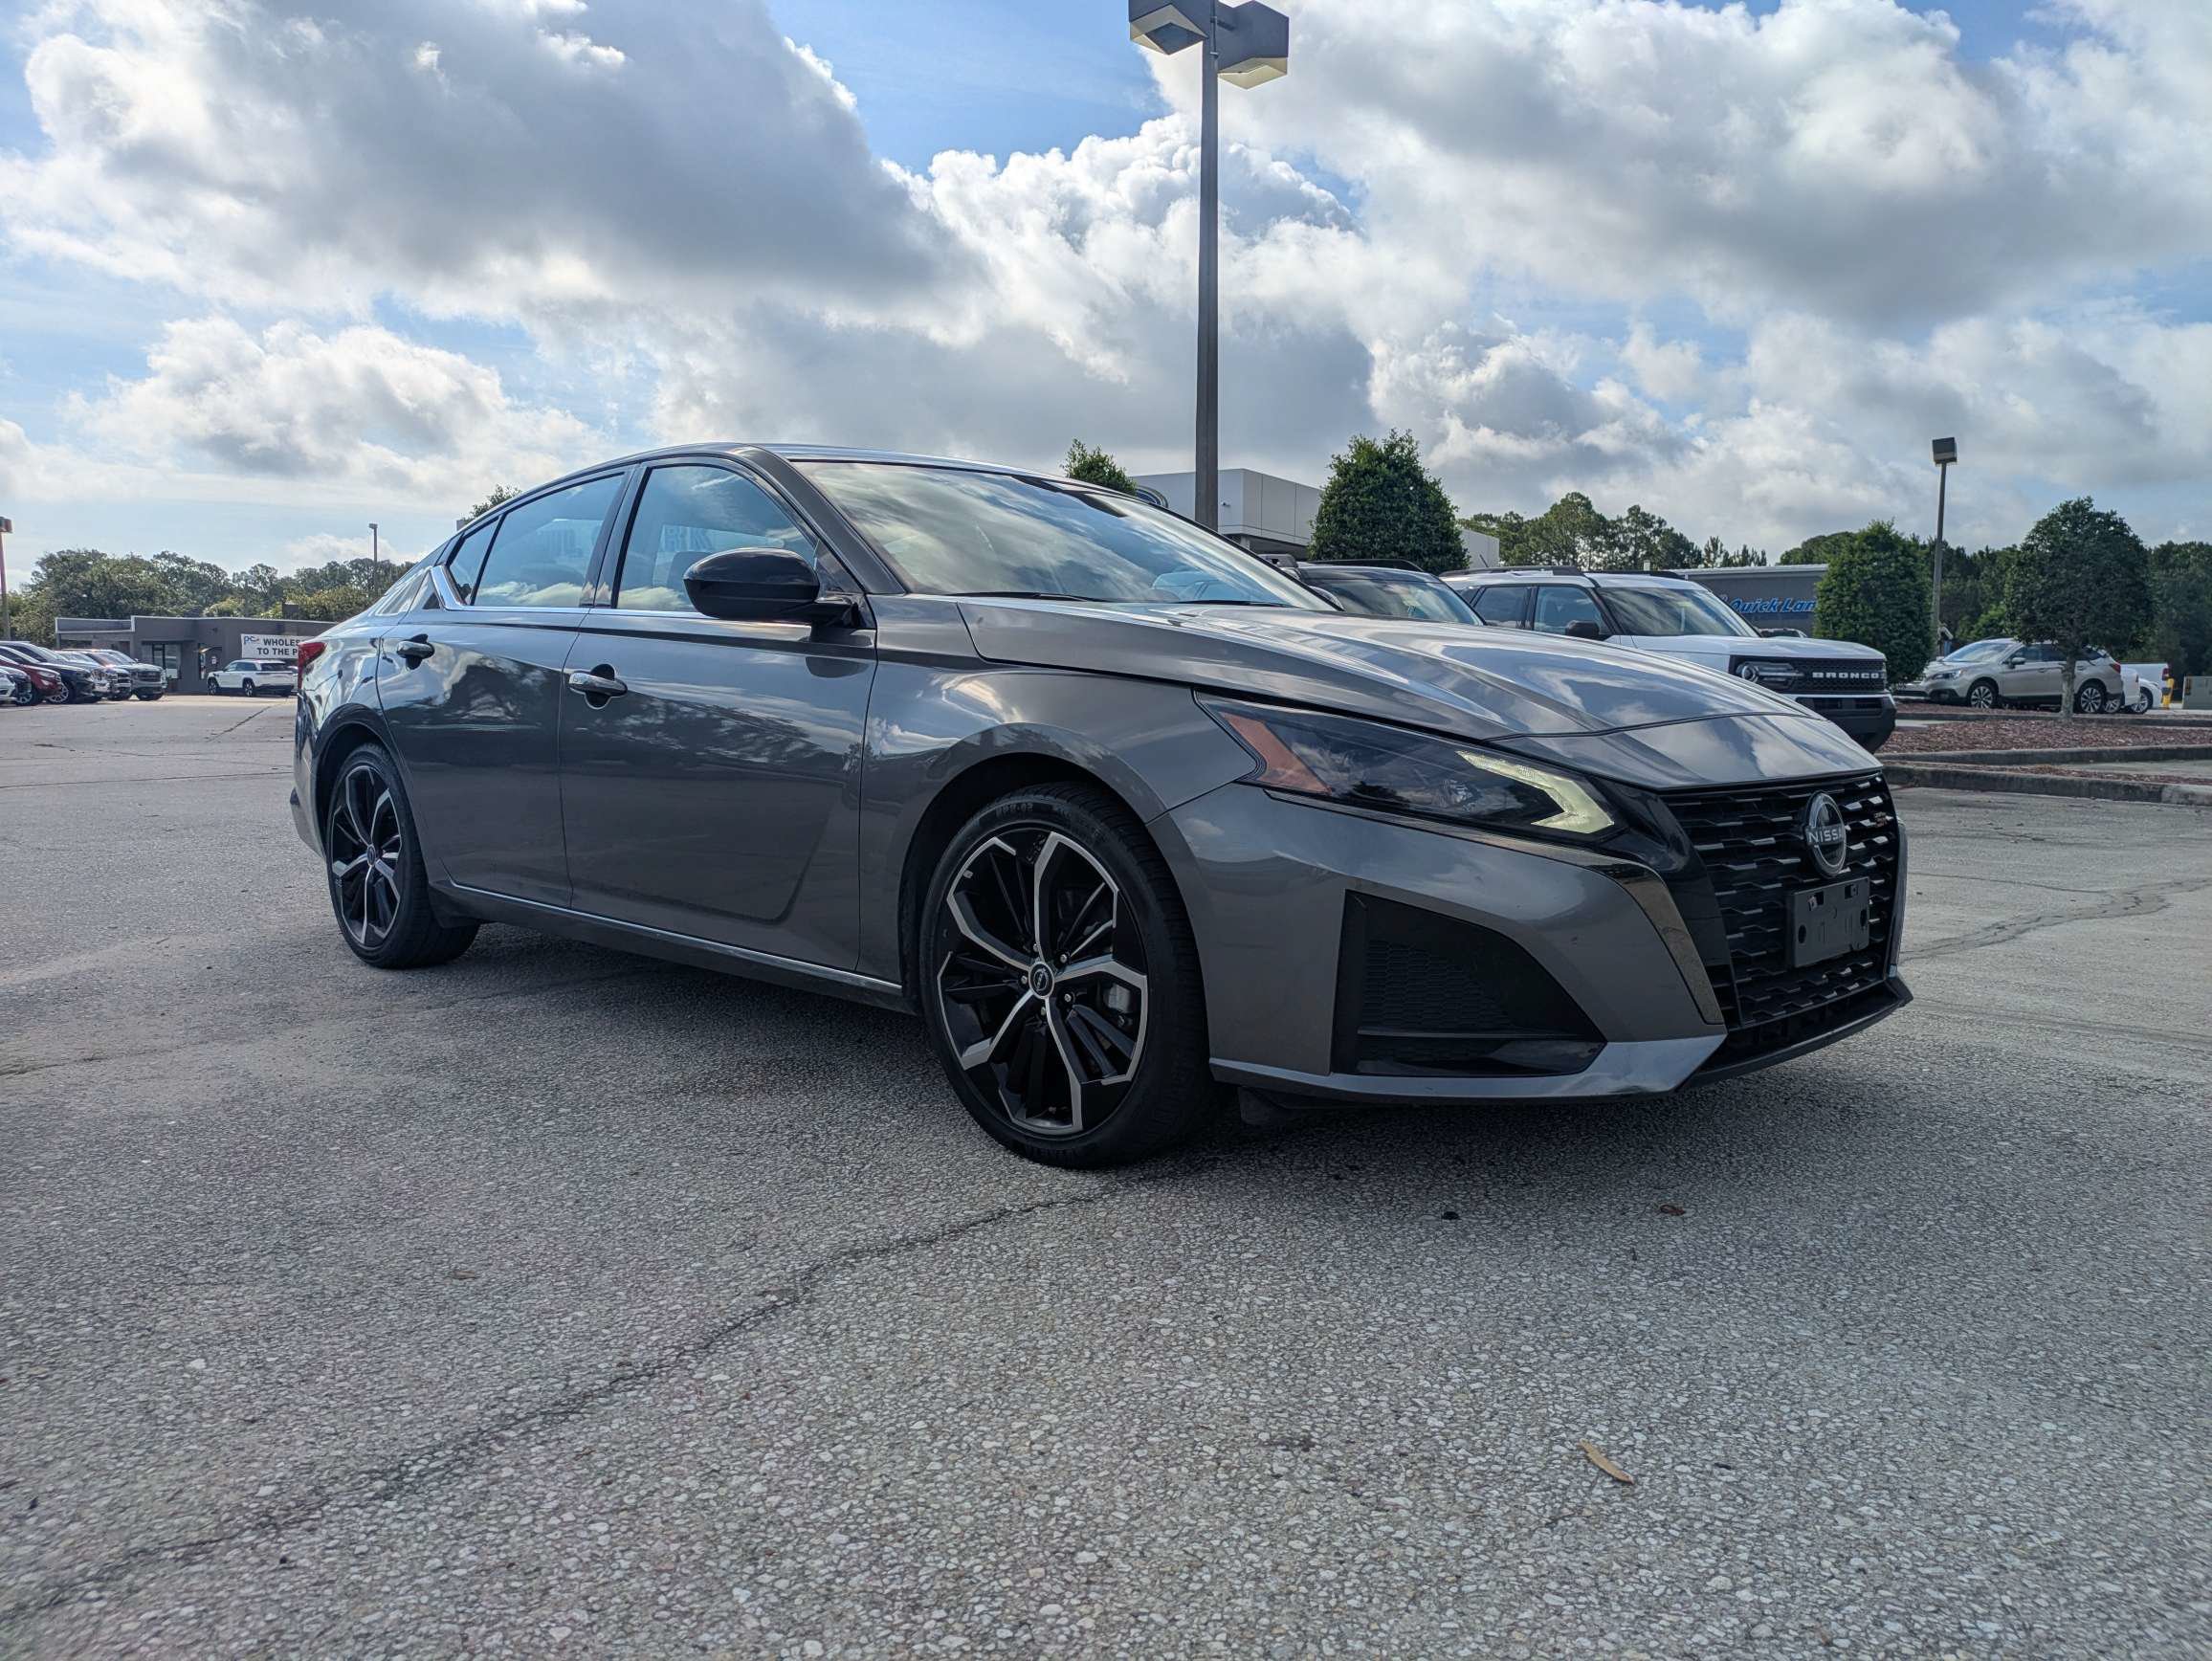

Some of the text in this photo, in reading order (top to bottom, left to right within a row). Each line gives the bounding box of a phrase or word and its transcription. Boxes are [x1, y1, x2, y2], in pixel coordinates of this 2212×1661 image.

[1730, 597, 1817, 613] Quick Lan
[263, 638, 300, 647] WHOLES
